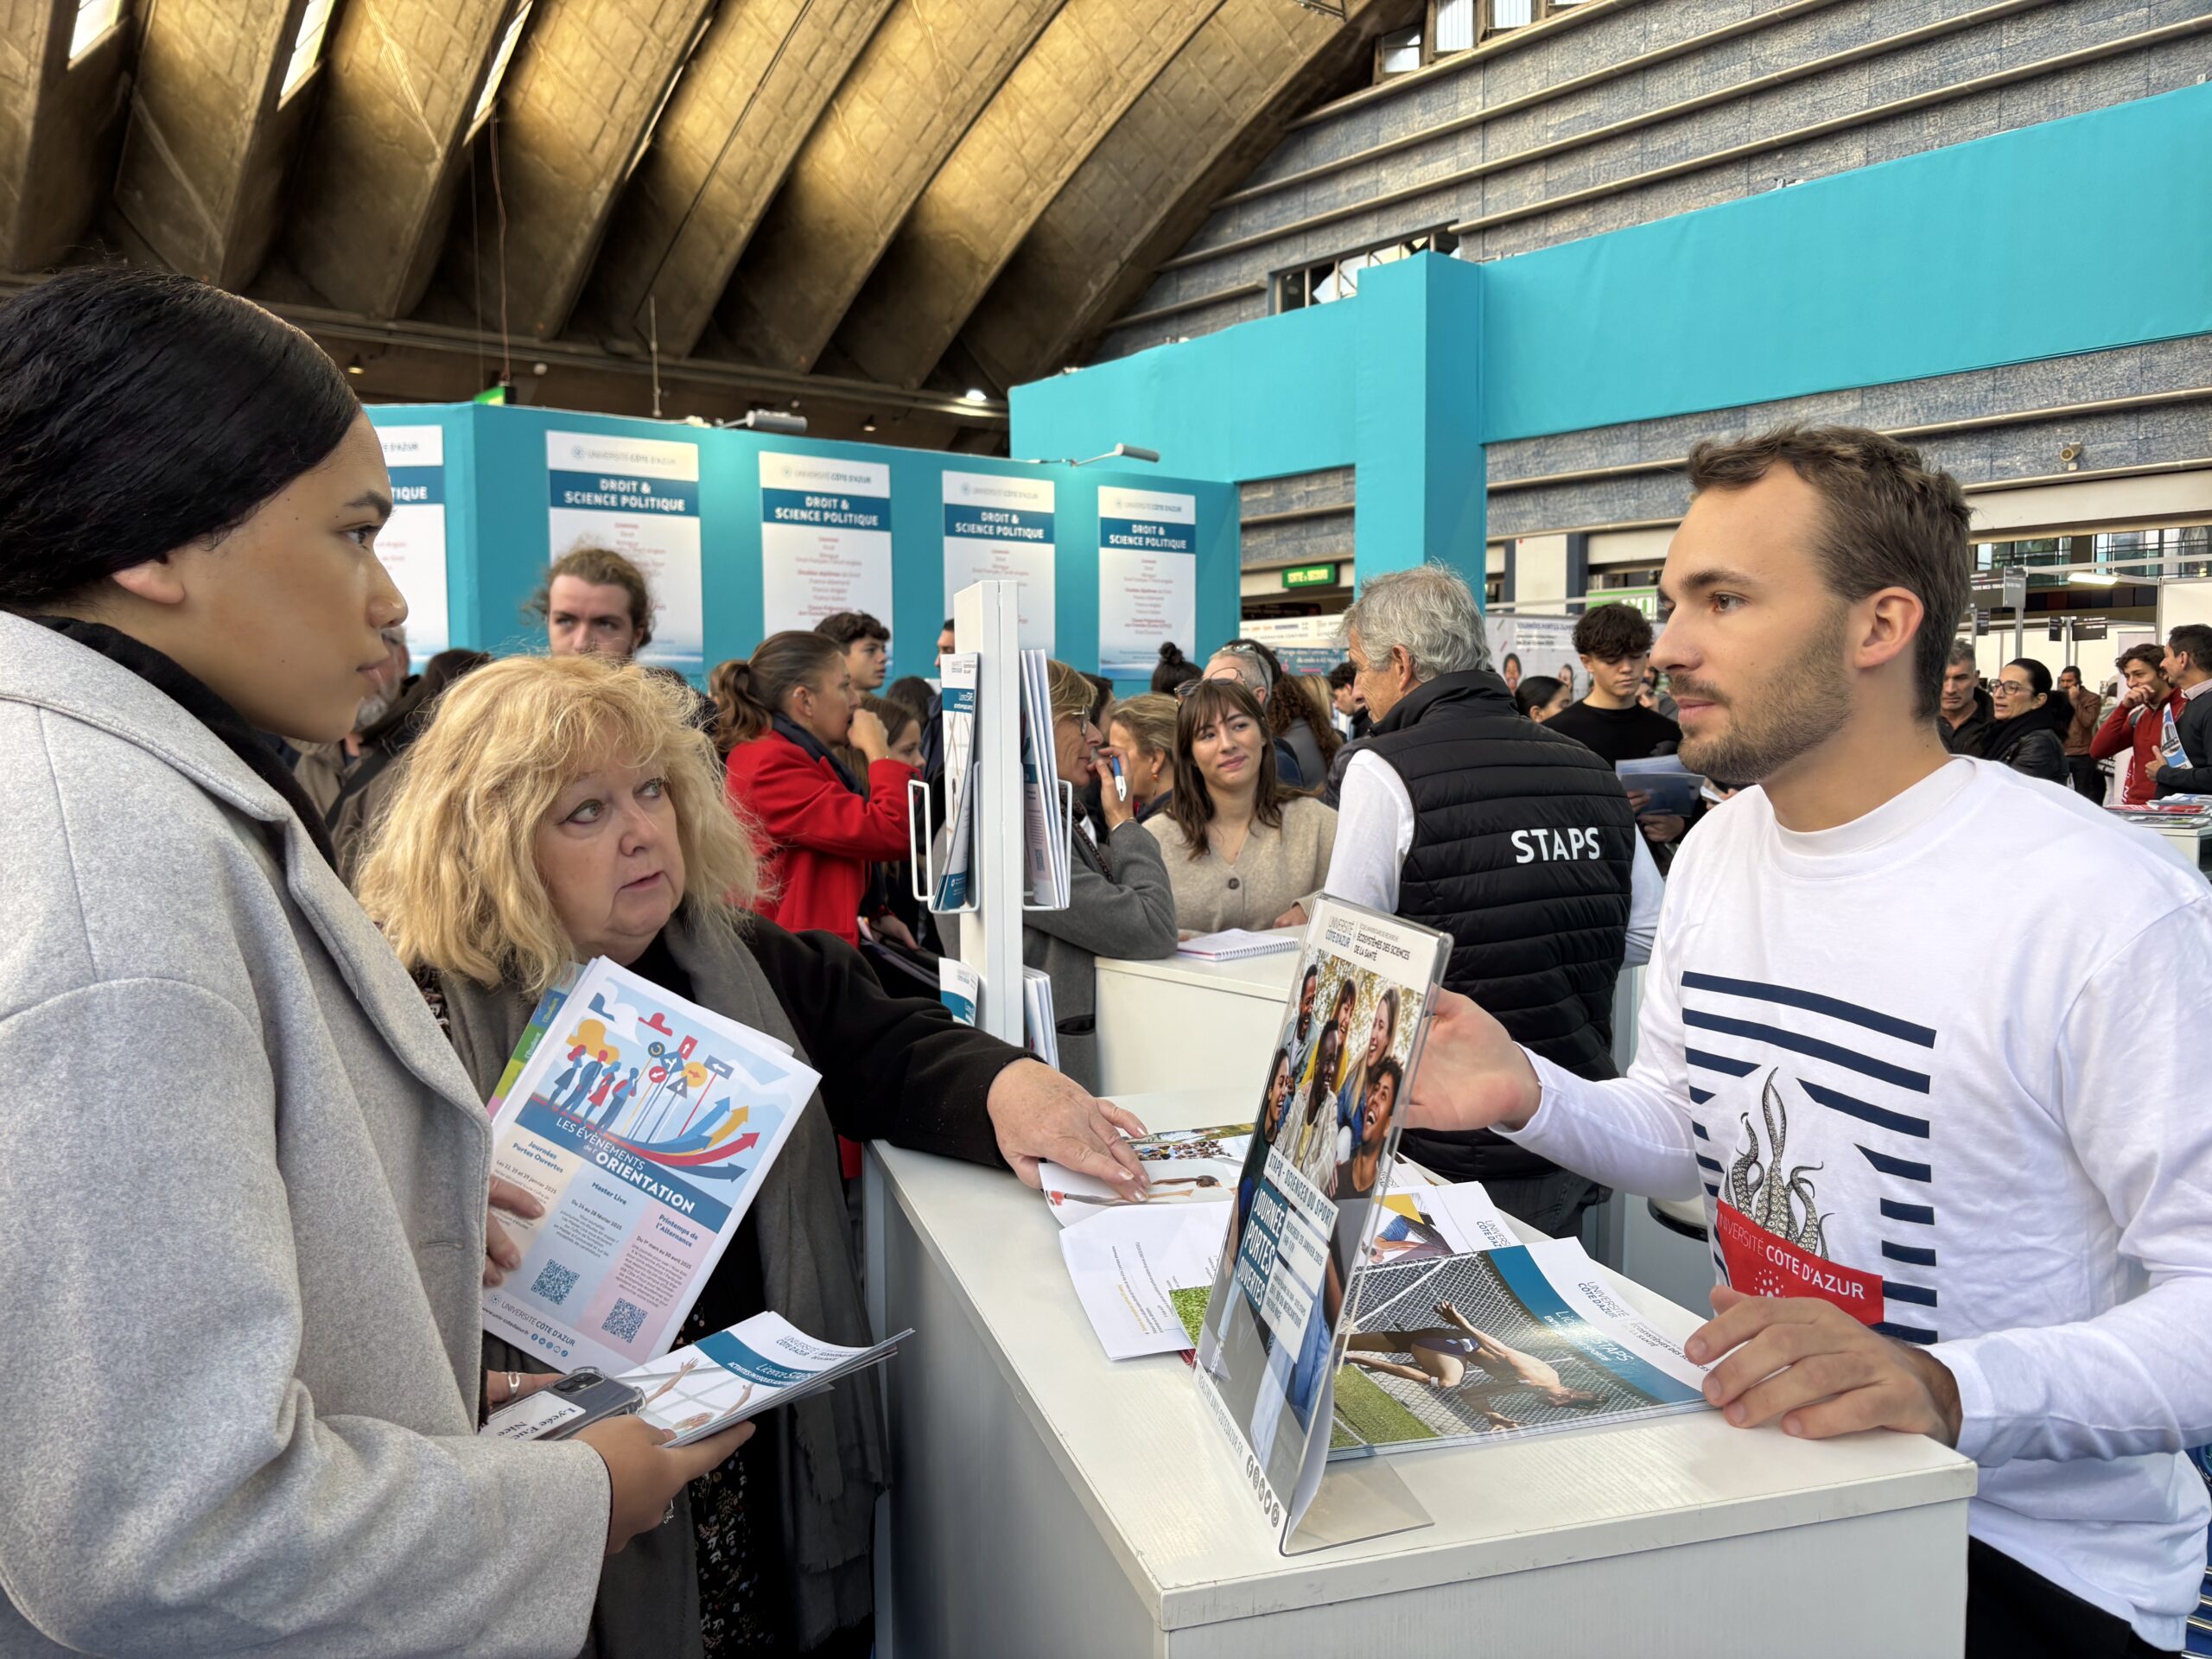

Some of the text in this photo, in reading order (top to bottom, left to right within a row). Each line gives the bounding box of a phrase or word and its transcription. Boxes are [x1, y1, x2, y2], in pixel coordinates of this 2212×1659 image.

[391, 486, 428, 501] TIQUE
[600, 478, 652, 494] DROIT &
[564, 490, 685, 512] SCIENCE POLITIQUE
[805, 496, 849, 511] DROIT &
[775, 507, 879, 526] SCIENCE POLITIQUE
[981, 512, 1020, 524] DROIT &
[955, 522, 1044, 539] SCIENCE POLITIQUE
[1132, 524, 1165, 536] DROIT &
[1109, 534, 1186, 550] SCIENCE POLITIQUE
[1510, 827, 1600, 863] STAPS
[1353, 944, 1361, 954] DE
[1363, 948, 1377, 962] SANTÉ
[1382, 942, 1391, 953] DES
[1389, 944, 1410, 961] SCIENCES
[528, 1141, 556, 1160] Journées
[556, 1117, 646, 1171] LES ÉVÈNEMENTS
[583, 1143, 593, 1153] de
[512, 1142, 563, 1173] Portes Ouvertes
[544, 1185, 556, 1194] 2025
[591, 1181, 627, 1205] Master Live
[1268, 1153, 1283, 1177] STAPS
[1284, 1169, 1309, 1203] SCIENCES
[1306, 1191, 1317, 1211] DU
[1314, 1199, 1334, 1228] SPORT
[1254, 1190, 1285, 1238] JOURNÉE
[610, 1221, 622, 1230] 2025
[655, 1223, 693, 1247] l'Alternance
[658, 1214, 699, 1240] Printemps de
[1244, 1219, 1275, 1275] PORTES
[1303, 1240, 1316, 1259] JANVIER
[1487, 1236, 1503, 1247] D'AZ
[647, 1243, 658, 1251] mars
[680, 1260, 691, 1269] 2025
[1718, 1212, 1865, 1300] NIVERSITÉ CÔTE D'AZUR
[1237, 1255, 1265, 1306] OUVERTES
[1578, 1282, 1598, 1300] CÔTE
[1592, 1298, 1619, 1319] D'AZUR
[1587, 1281, 1630, 1318] UNIVERSITÉ
[501, 1301, 575, 1346] UNIVERSITÉ CÔTE D'AZUR
[1668, 1346, 1682, 1358] DES
[755, 1363, 787, 1379] Licence
[538, 1407, 577, 1427] Lycée
[497, 1421, 528, 1437] Nice
